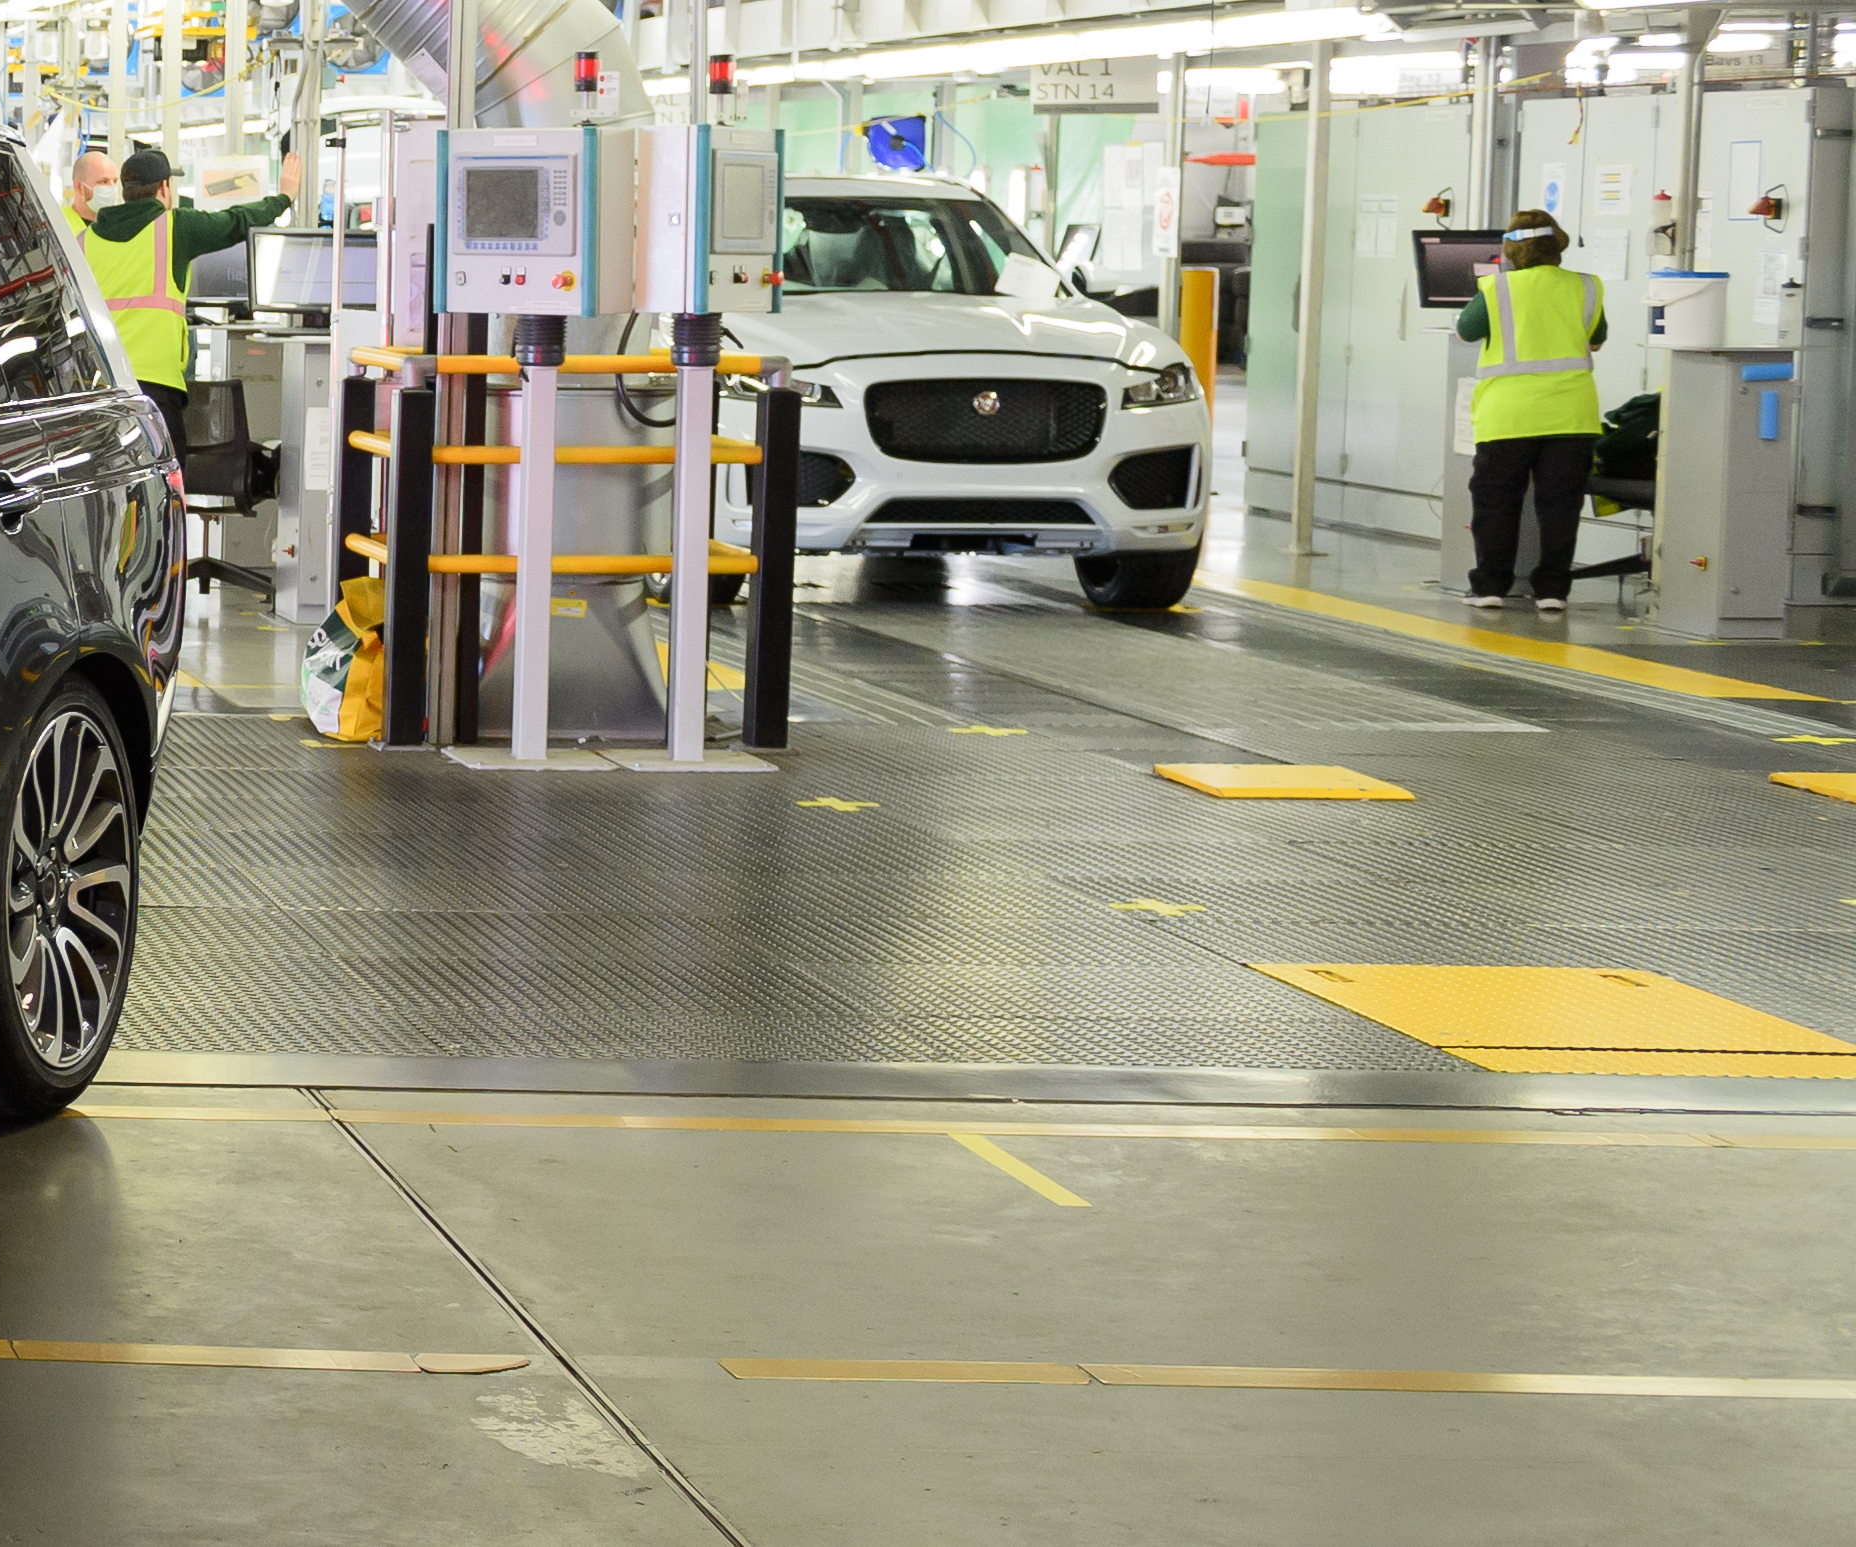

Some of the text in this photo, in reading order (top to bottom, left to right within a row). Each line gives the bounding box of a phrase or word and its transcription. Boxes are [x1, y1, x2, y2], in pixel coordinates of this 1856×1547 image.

[1040, 59, 1112, 76] VAL 1
[1037, 83, 1114, 100] STN 14
